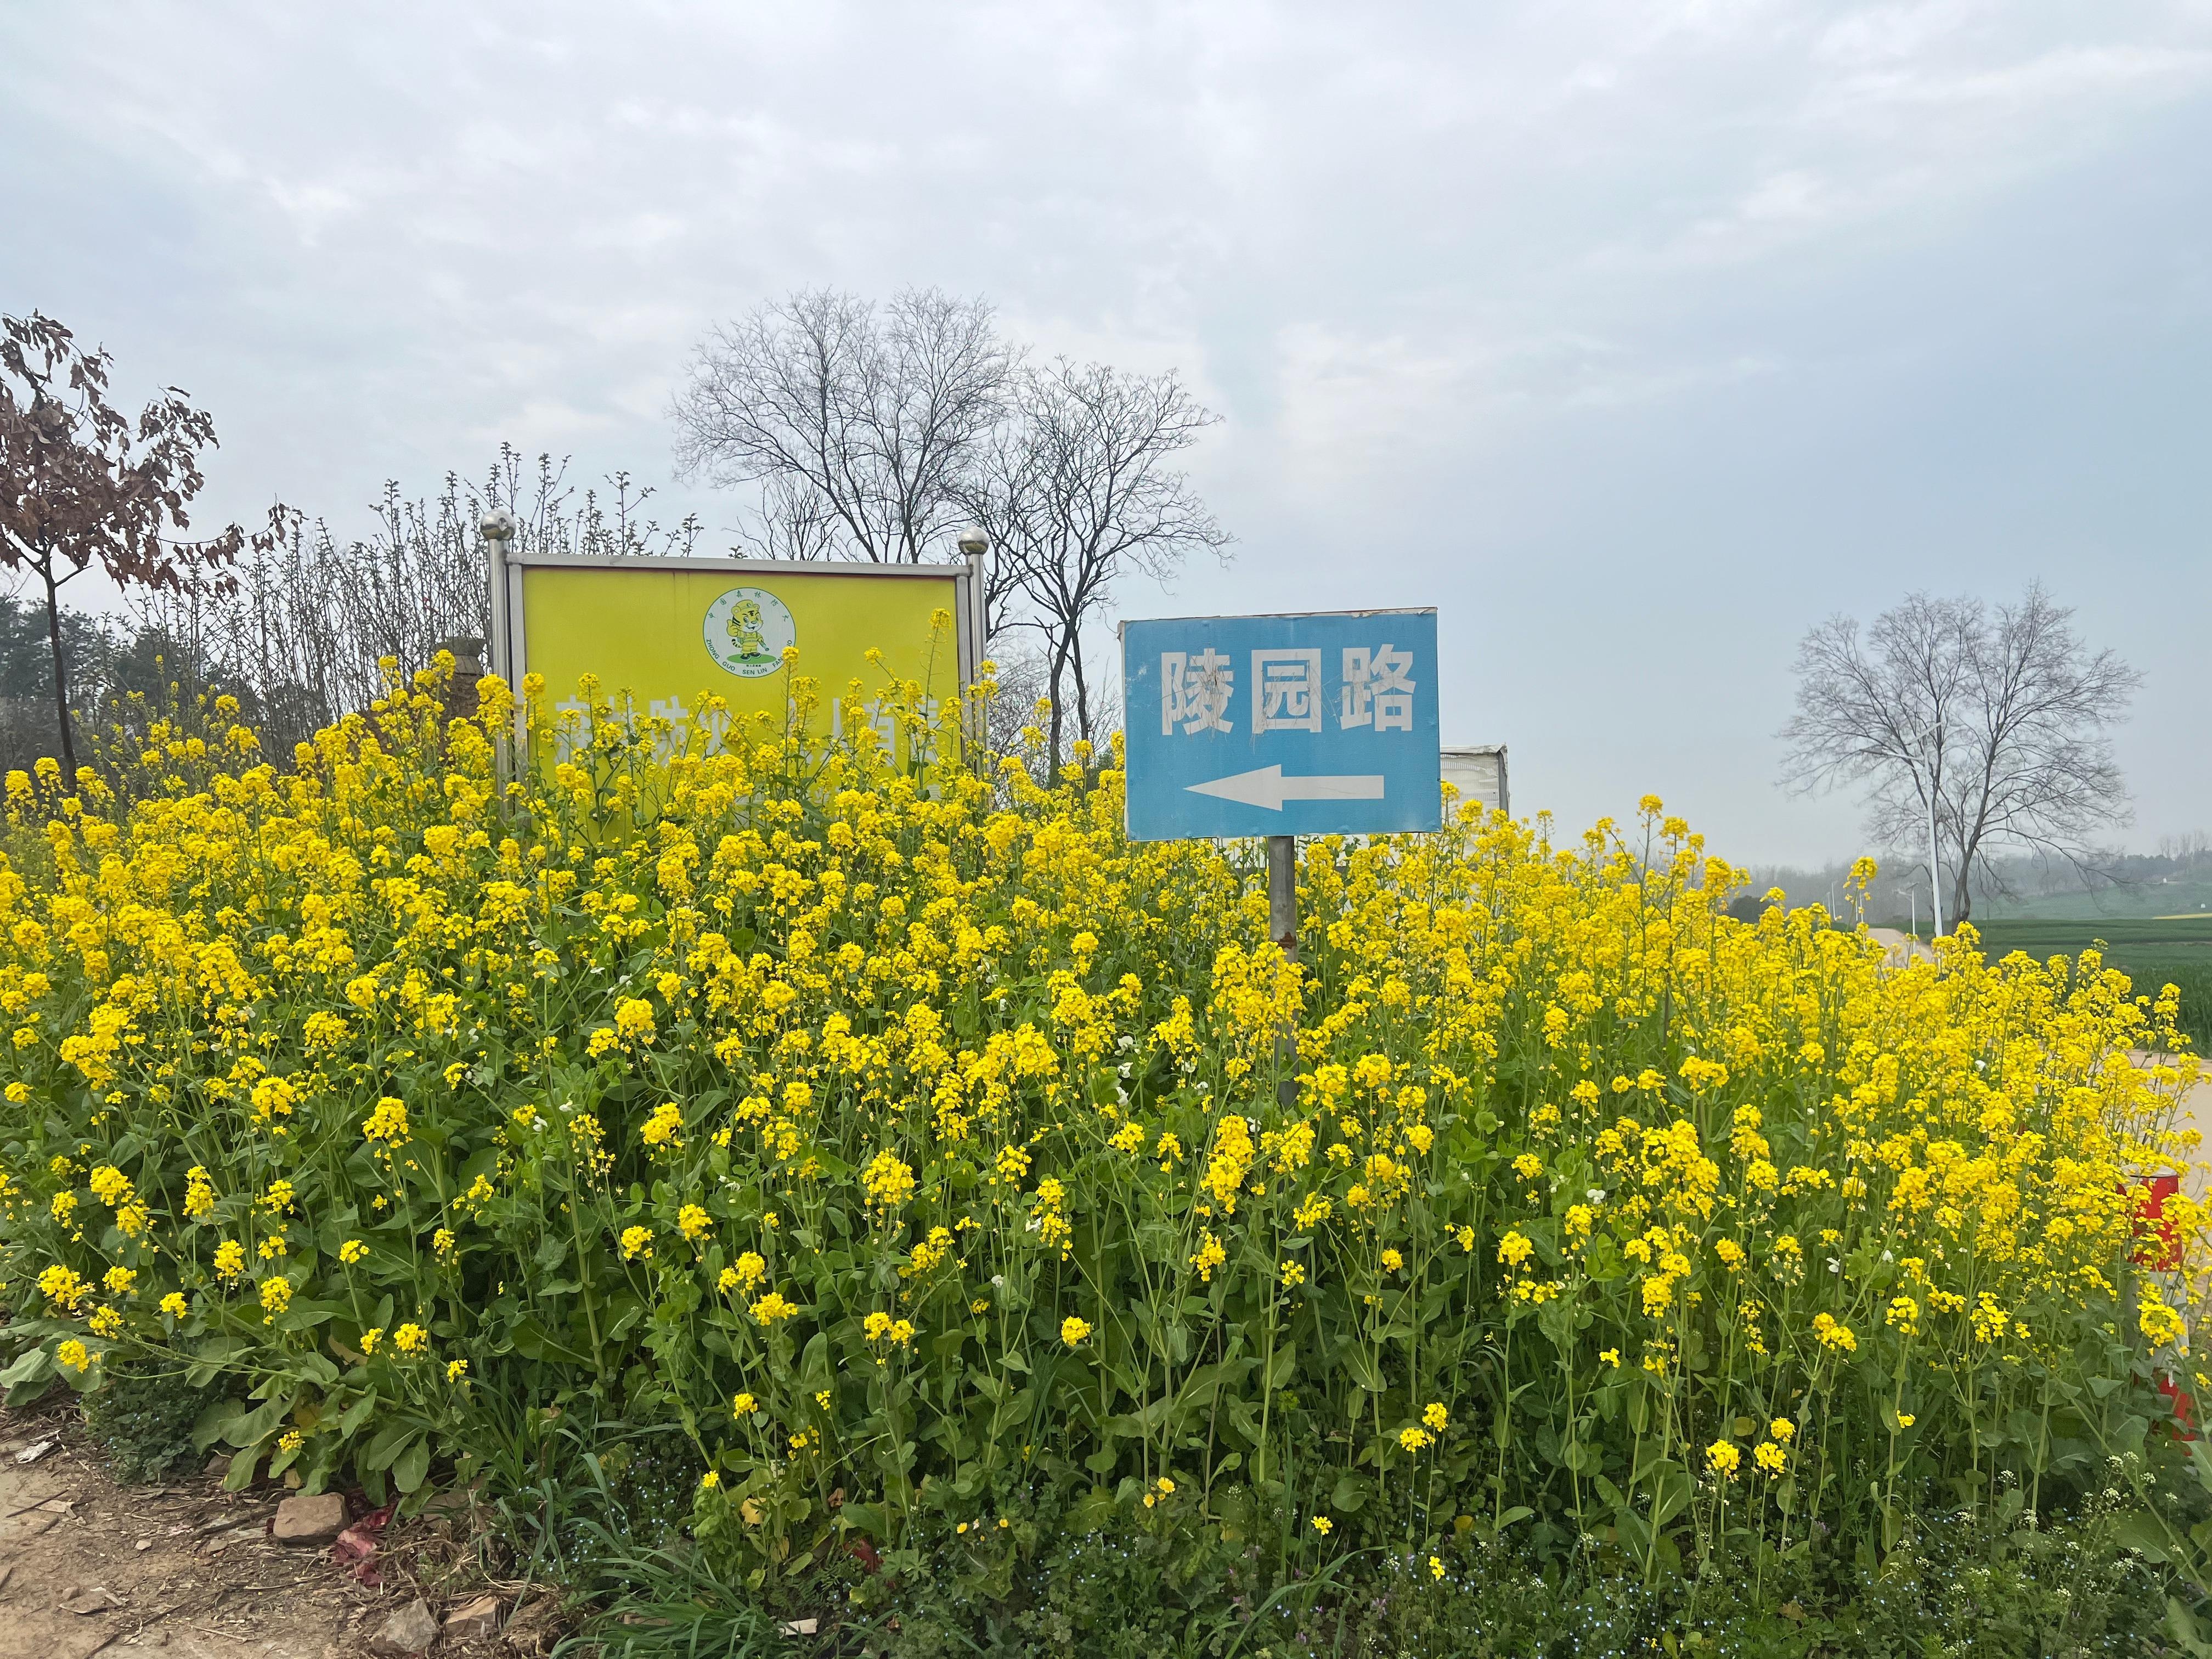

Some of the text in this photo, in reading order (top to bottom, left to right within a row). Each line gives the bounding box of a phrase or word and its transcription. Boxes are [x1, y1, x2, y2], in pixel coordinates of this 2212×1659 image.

[706, 639, 720, 659] ZHONG
[723, 661, 736, 671] GUO
[1160, 644, 1417, 736] 陵园路
